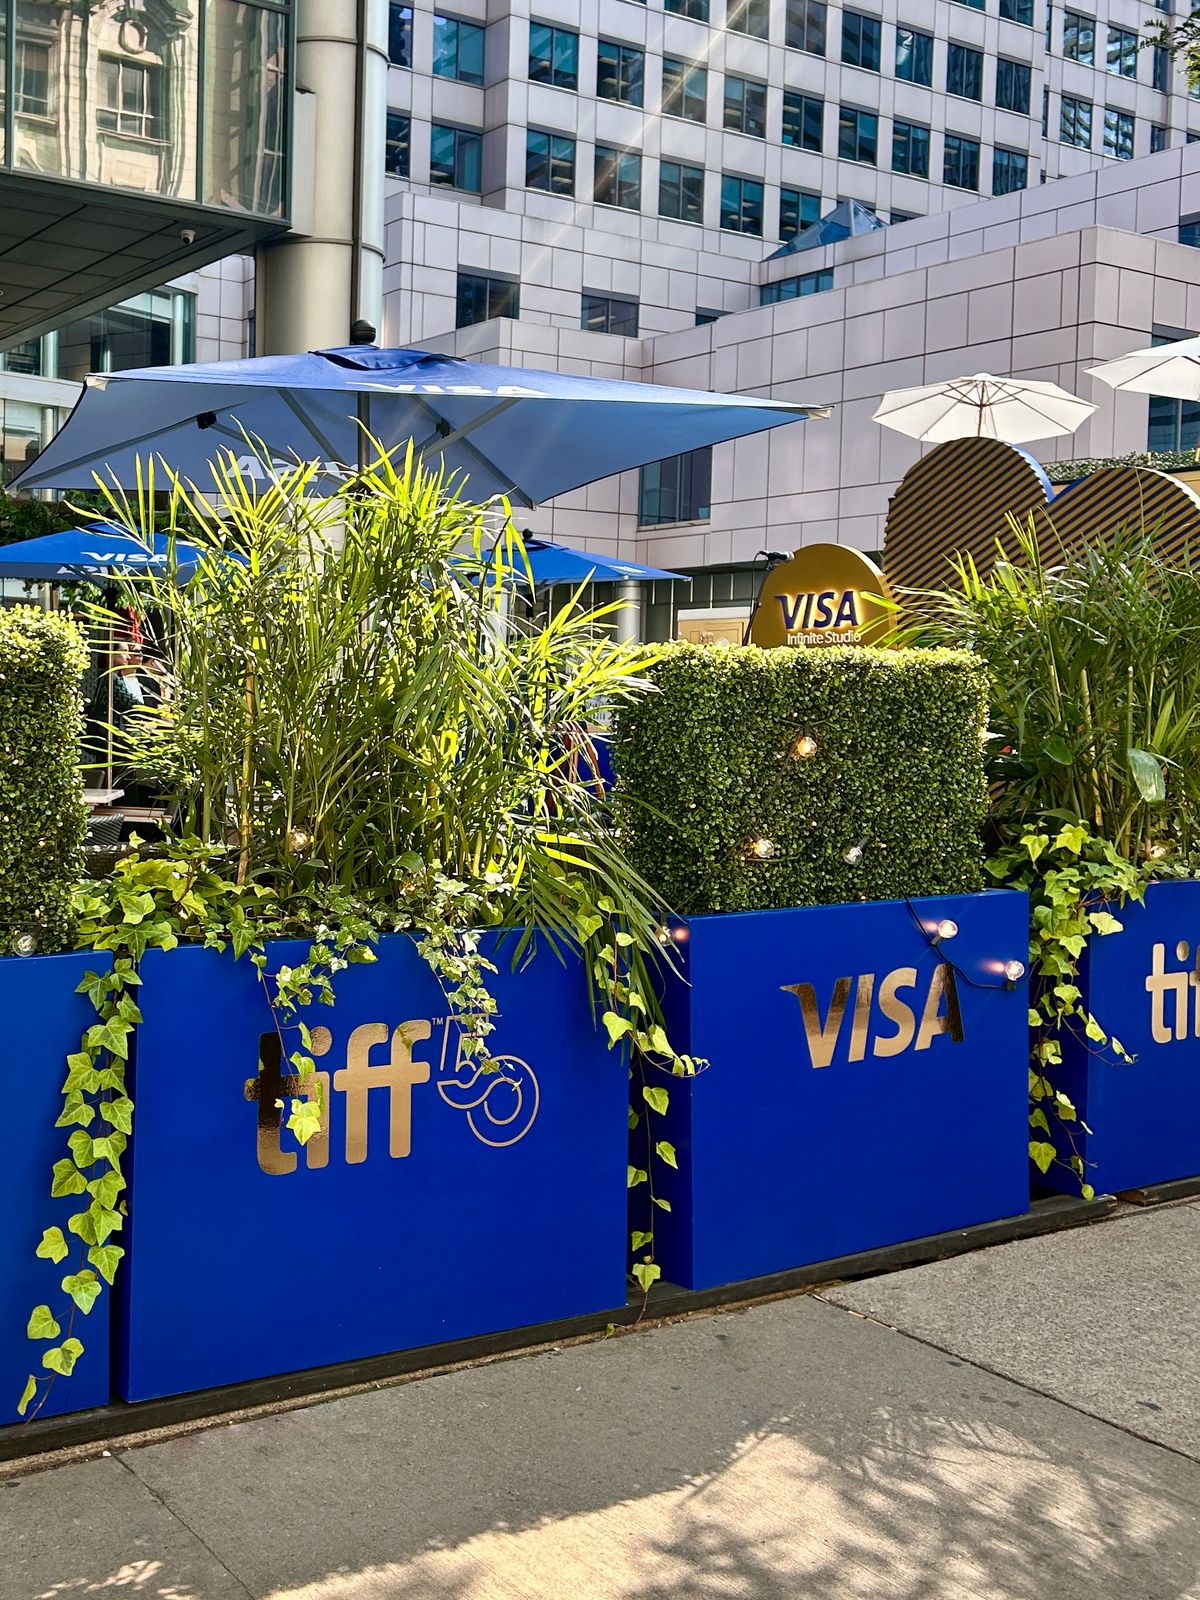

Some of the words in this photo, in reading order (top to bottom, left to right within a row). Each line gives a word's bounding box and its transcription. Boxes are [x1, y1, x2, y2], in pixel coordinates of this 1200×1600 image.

[346, 381, 551, 396] VISA
[80, 551, 171, 562] VISA
[774, 590, 859, 630] VISA
[787, 631, 824, 645] Infinite
[824, 629, 862, 644] Studio
[779, 963, 965, 1068] VISA
[244, 1019, 432, 1176] tiff
